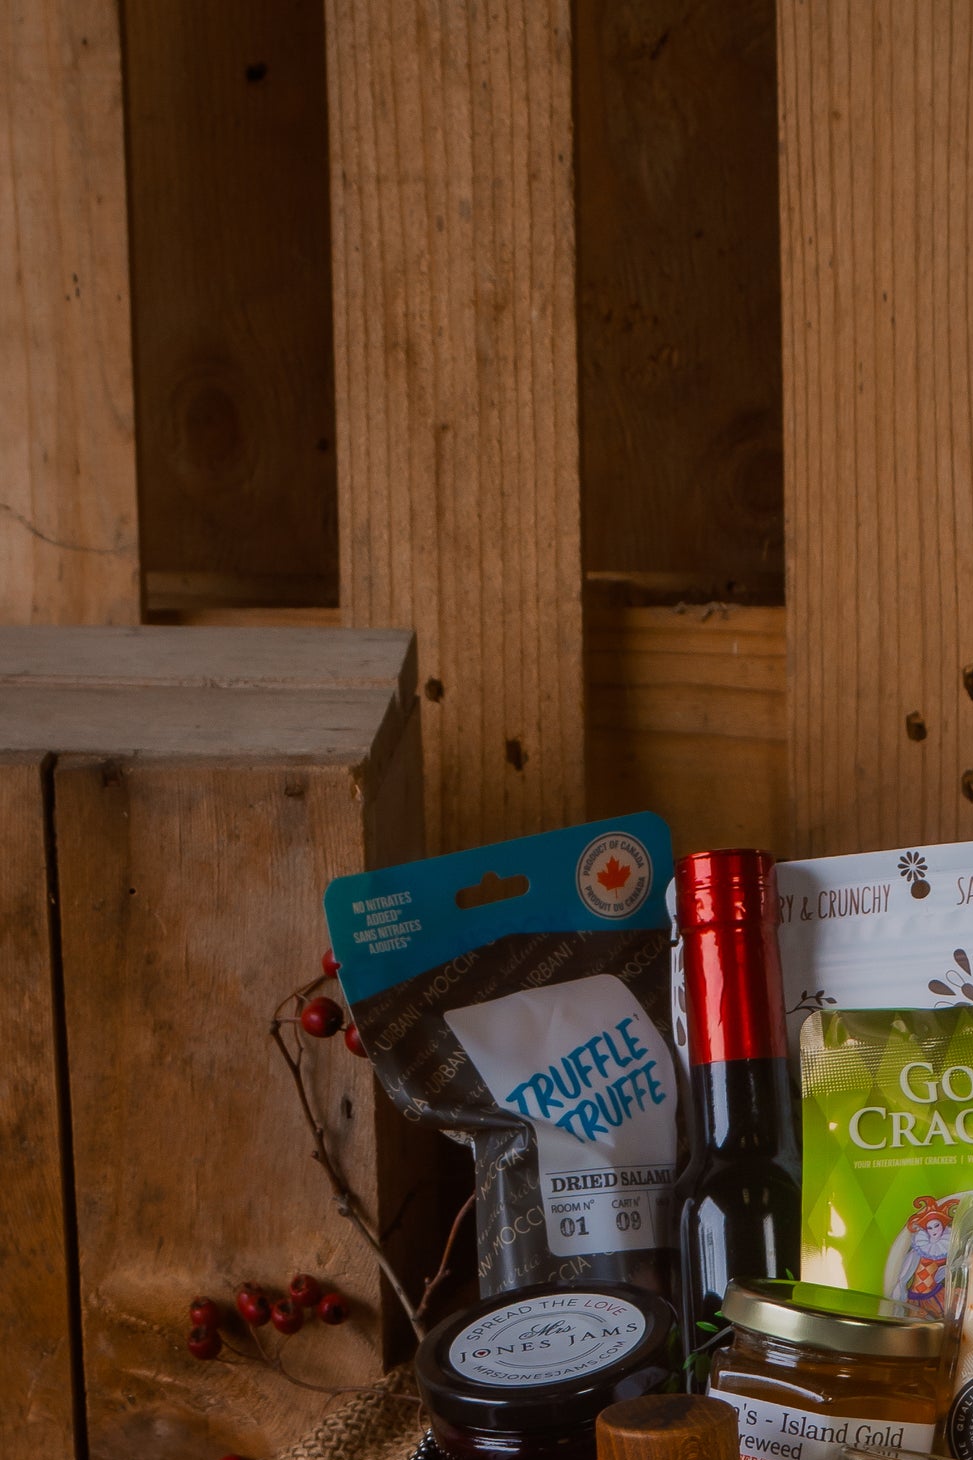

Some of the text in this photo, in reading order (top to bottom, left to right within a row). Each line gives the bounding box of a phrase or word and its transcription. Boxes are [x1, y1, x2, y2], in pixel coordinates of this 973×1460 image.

[583, 840, 644, 876] PRODUCT OF CANADA
[352, 891, 412, 915] NO NITRATES
[585, 876, 646, 912] PRODUIT DU CANADA
[776, 885, 890, 924] RY & CRUNCHY
[353, 919, 423, 944] SANS NITRATES
[374, 1004, 423, 1051] URBANI
[422, 951, 480, 1005] MOCCIA
[403, 1096, 429, 1122] CIA
[425, 1044, 468, 1093] URBAN
[505, 1018, 648, 1120] TRUFFLE
[555, 1060, 666, 1143] TRUFFE
[854, 1160, 871, 1169] YOUR
[872, 1157, 923, 1168] ENTERTAINMENT
[924, 1155, 957, 1165] CRACKERS
[551, 1173, 619, 1193] DRIED
[621, 1169, 672, 1186] SALAMI
[551, 1203, 581, 1214] ROOM
[611, 1199, 632, 1209] CART
[559, 1211, 642, 1237] 01 09
[493, 1205, 545, 1255] MOCCI
[467, 1299, 628, 1341] SPREAD THE LOVE
[518, 1320, 577, 1340] Mrs
[459, 1322, 638, 1363] JONES JAMS
[473, 1340, 627, 1380] MRSJONESJAMS.COM
[740, 1433, 803, 1460] reweed
[780, 1412, 848, 1444] Island
[855, 1424, 904, 1449] Gold
